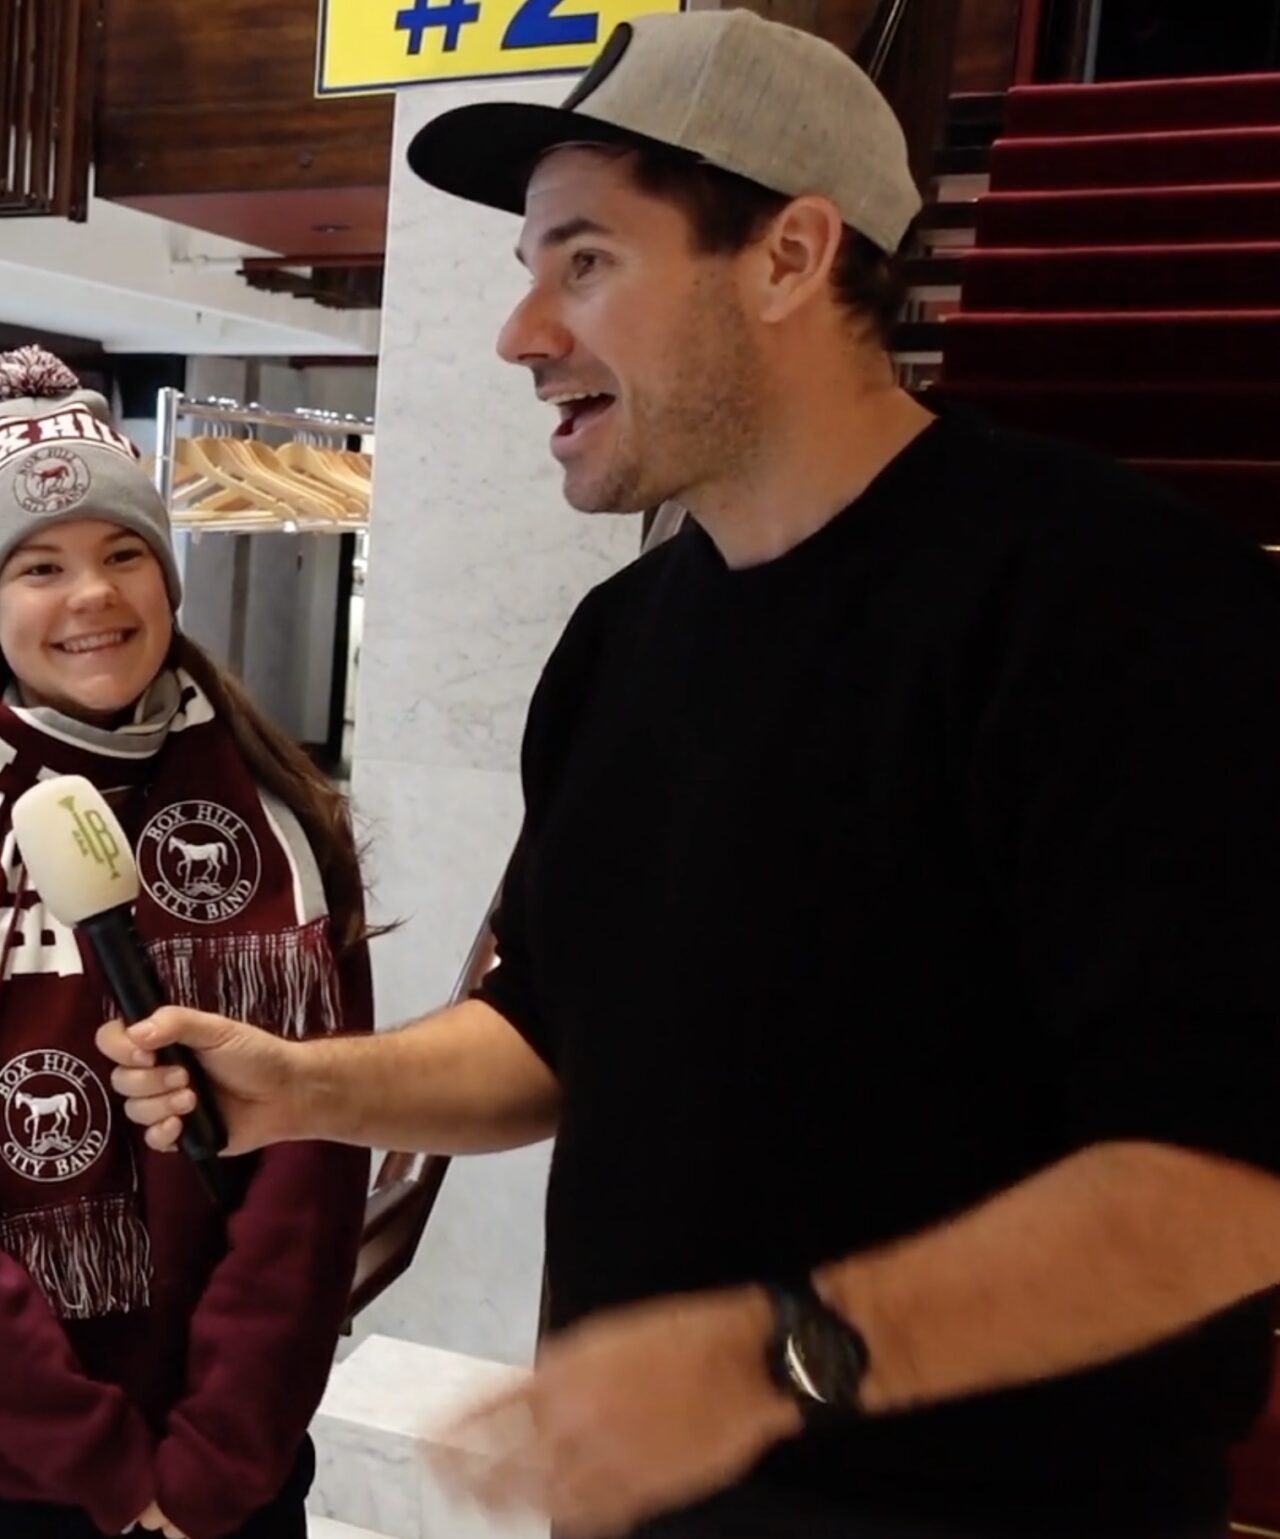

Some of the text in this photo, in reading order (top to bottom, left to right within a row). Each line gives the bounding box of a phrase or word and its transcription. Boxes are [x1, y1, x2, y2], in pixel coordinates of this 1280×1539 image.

[146, 804, 242, 842] BOX HILL
[152, 879, 252, 919] CITY BAND
[42, 1053, 90, 1088] HILL
[3, 1130, 103, 1176] CITY BAND
